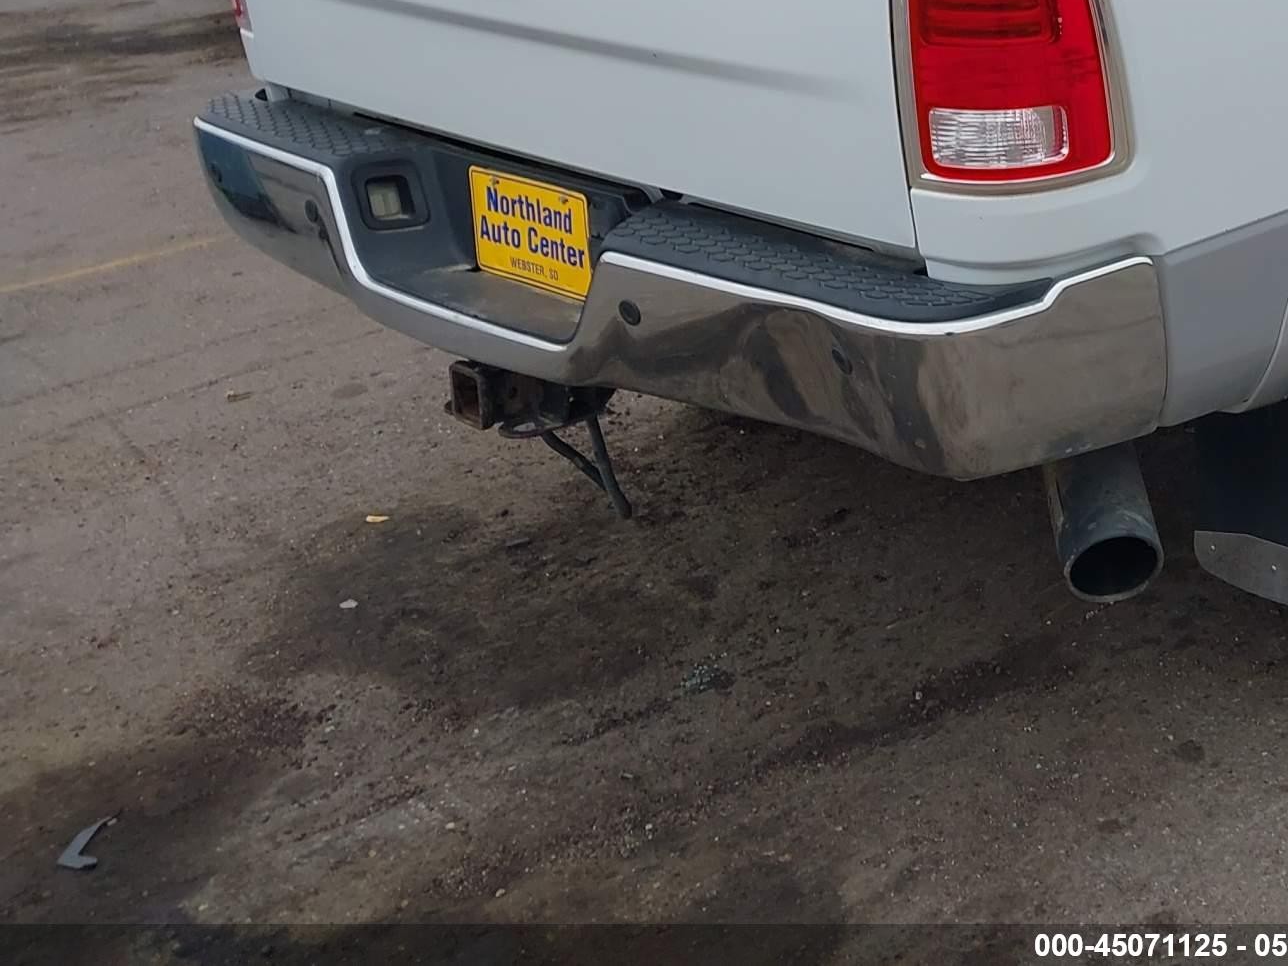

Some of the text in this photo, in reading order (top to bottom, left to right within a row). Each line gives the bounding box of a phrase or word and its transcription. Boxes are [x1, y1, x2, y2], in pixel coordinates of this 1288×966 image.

[486, 186, 573, 234] Northland
[480, 215, 585, 269] Auto Center
